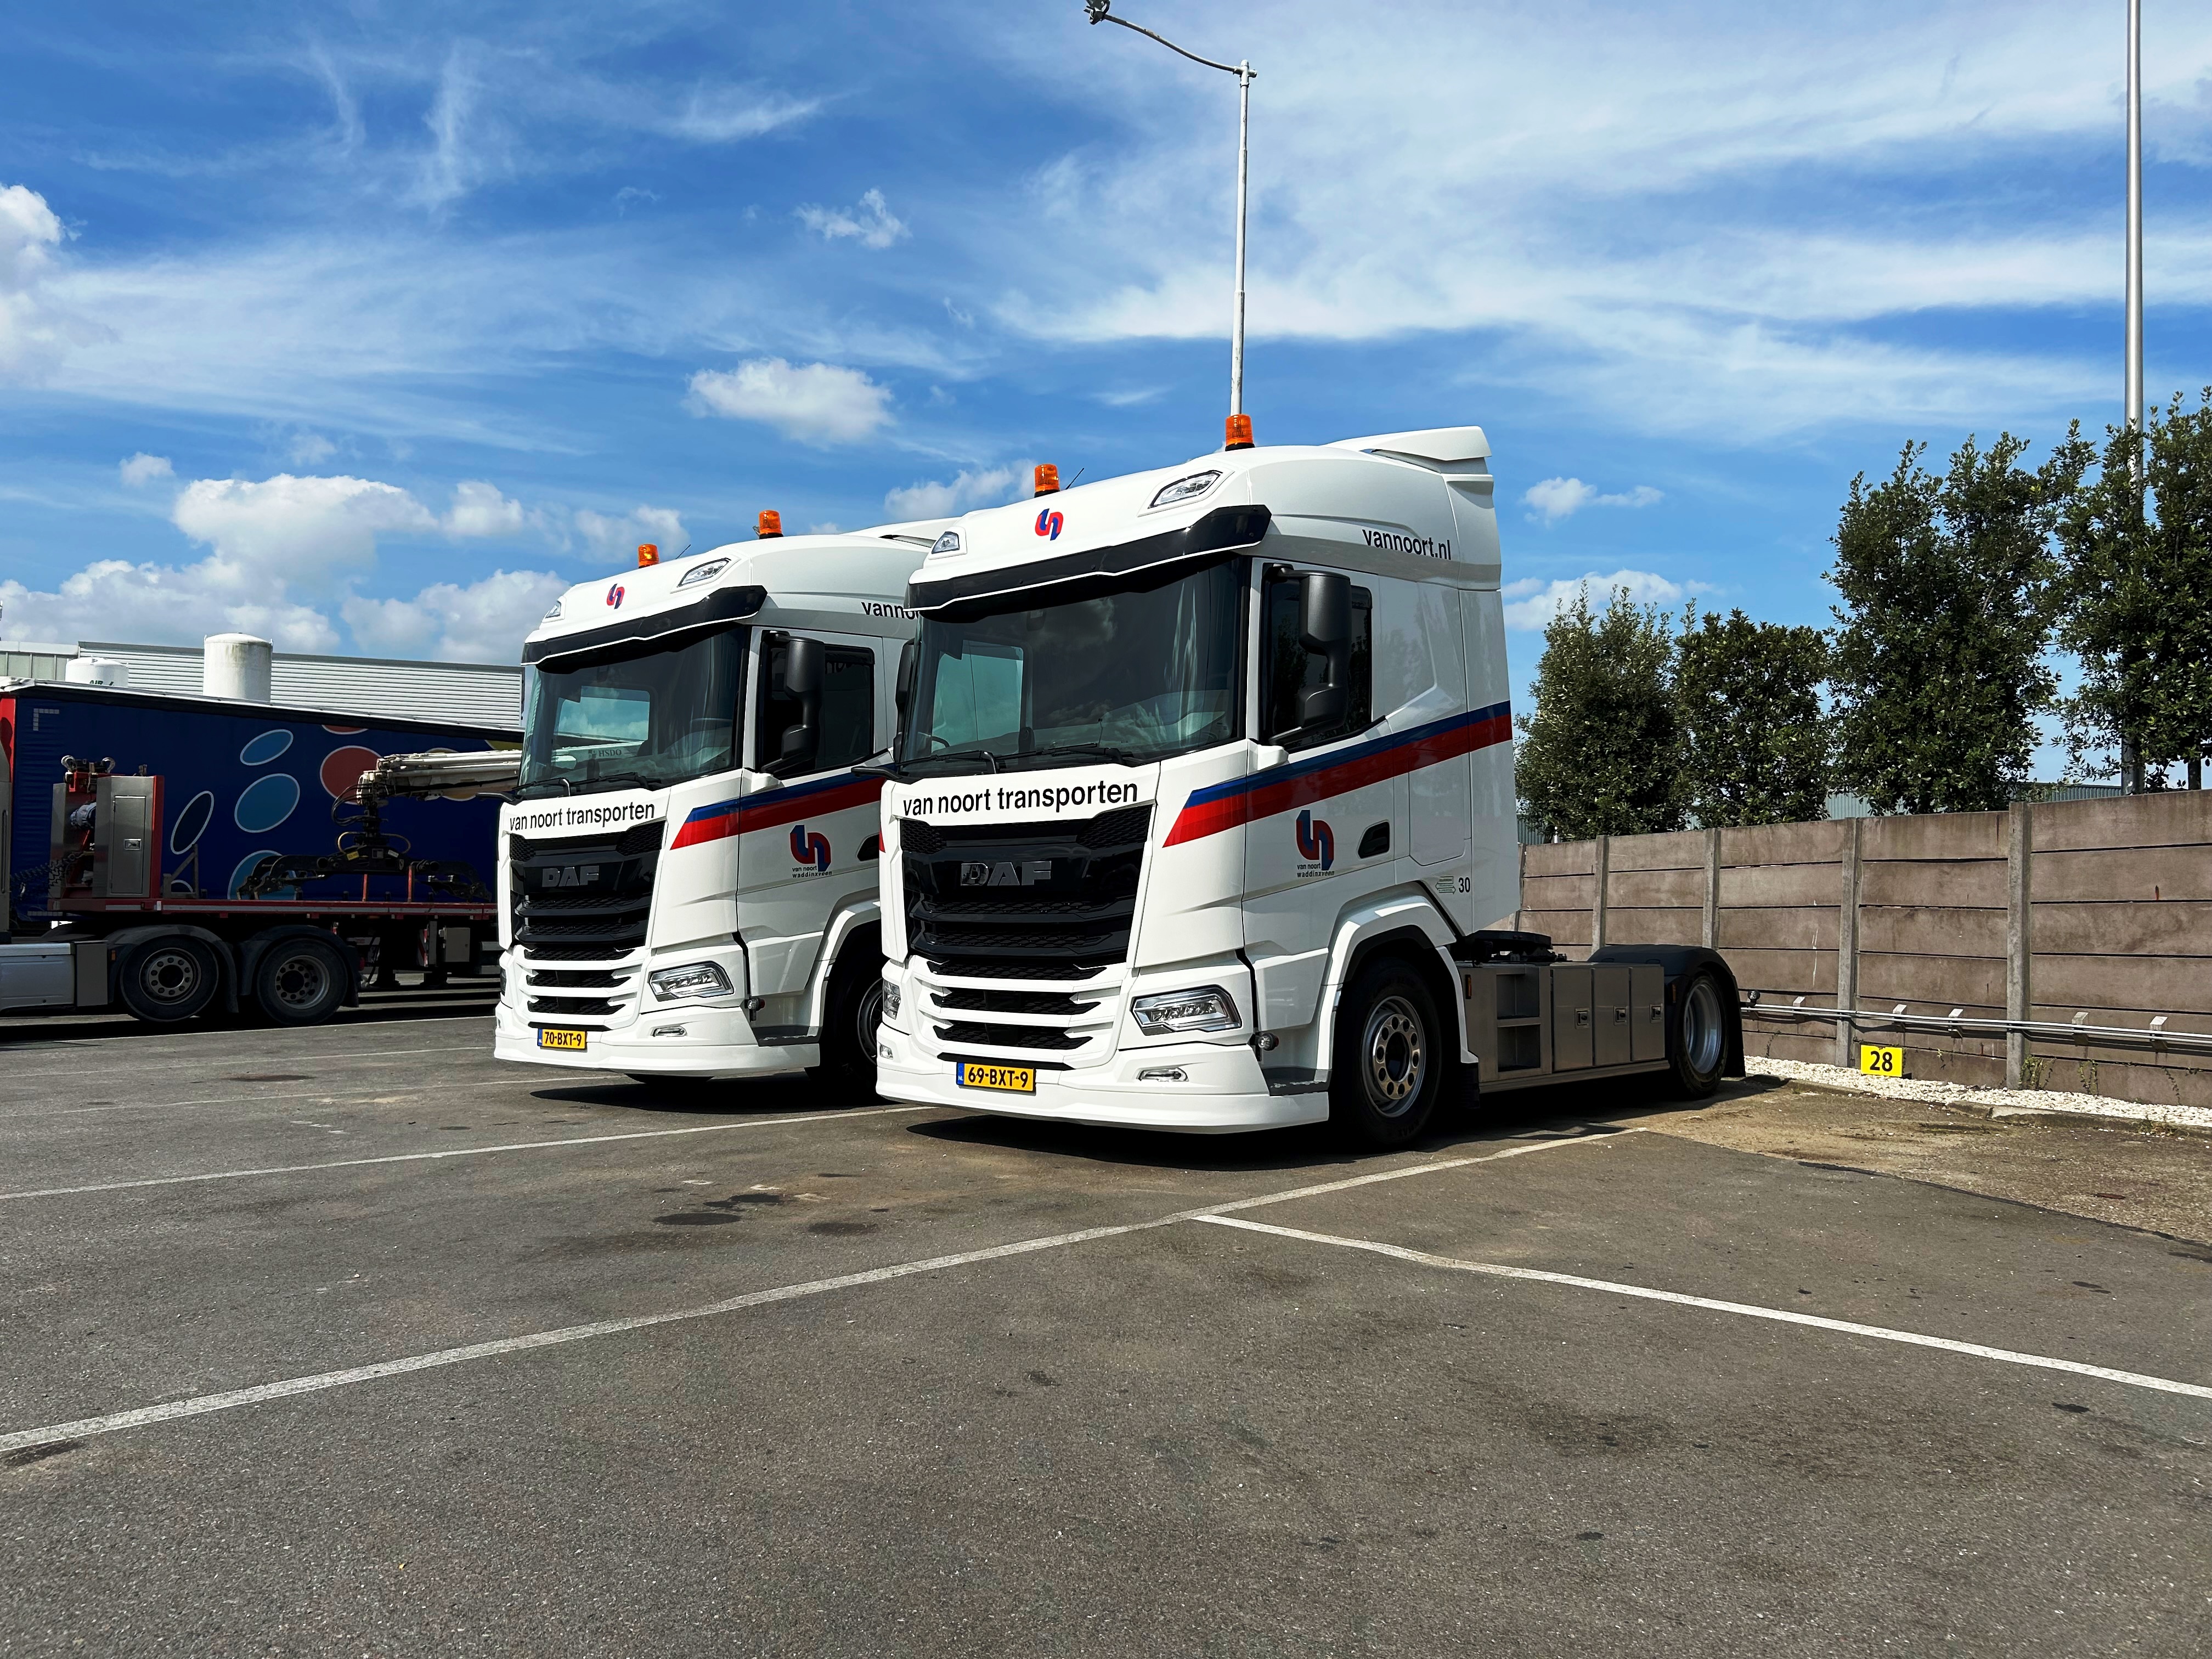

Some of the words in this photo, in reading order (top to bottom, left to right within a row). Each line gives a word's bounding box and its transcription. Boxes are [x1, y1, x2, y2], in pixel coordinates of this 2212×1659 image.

[1362, 529, 1452, 560] vannoort.nl
[861, 601, 919, 620] vanno
[903, 798, 933, 816] van
[938, 788, 991, 813] noort
[997, 780, 1138, 812] transporten
[510, 815, 527, 831] van
[530, 809, 562, 829] noort
[566, 802, 654, 827] transporten
[541, 865, 600, 887] DAF
[960, 860, 1052, 887] DAF
[1458, 877, 1470, 893] 30
[544, 1031, 582, 1046] 70-BXT-9
[1870, 1050, 1893, 1072] 28
[968, 1066, 1029, 1088] 69-BXT-9
